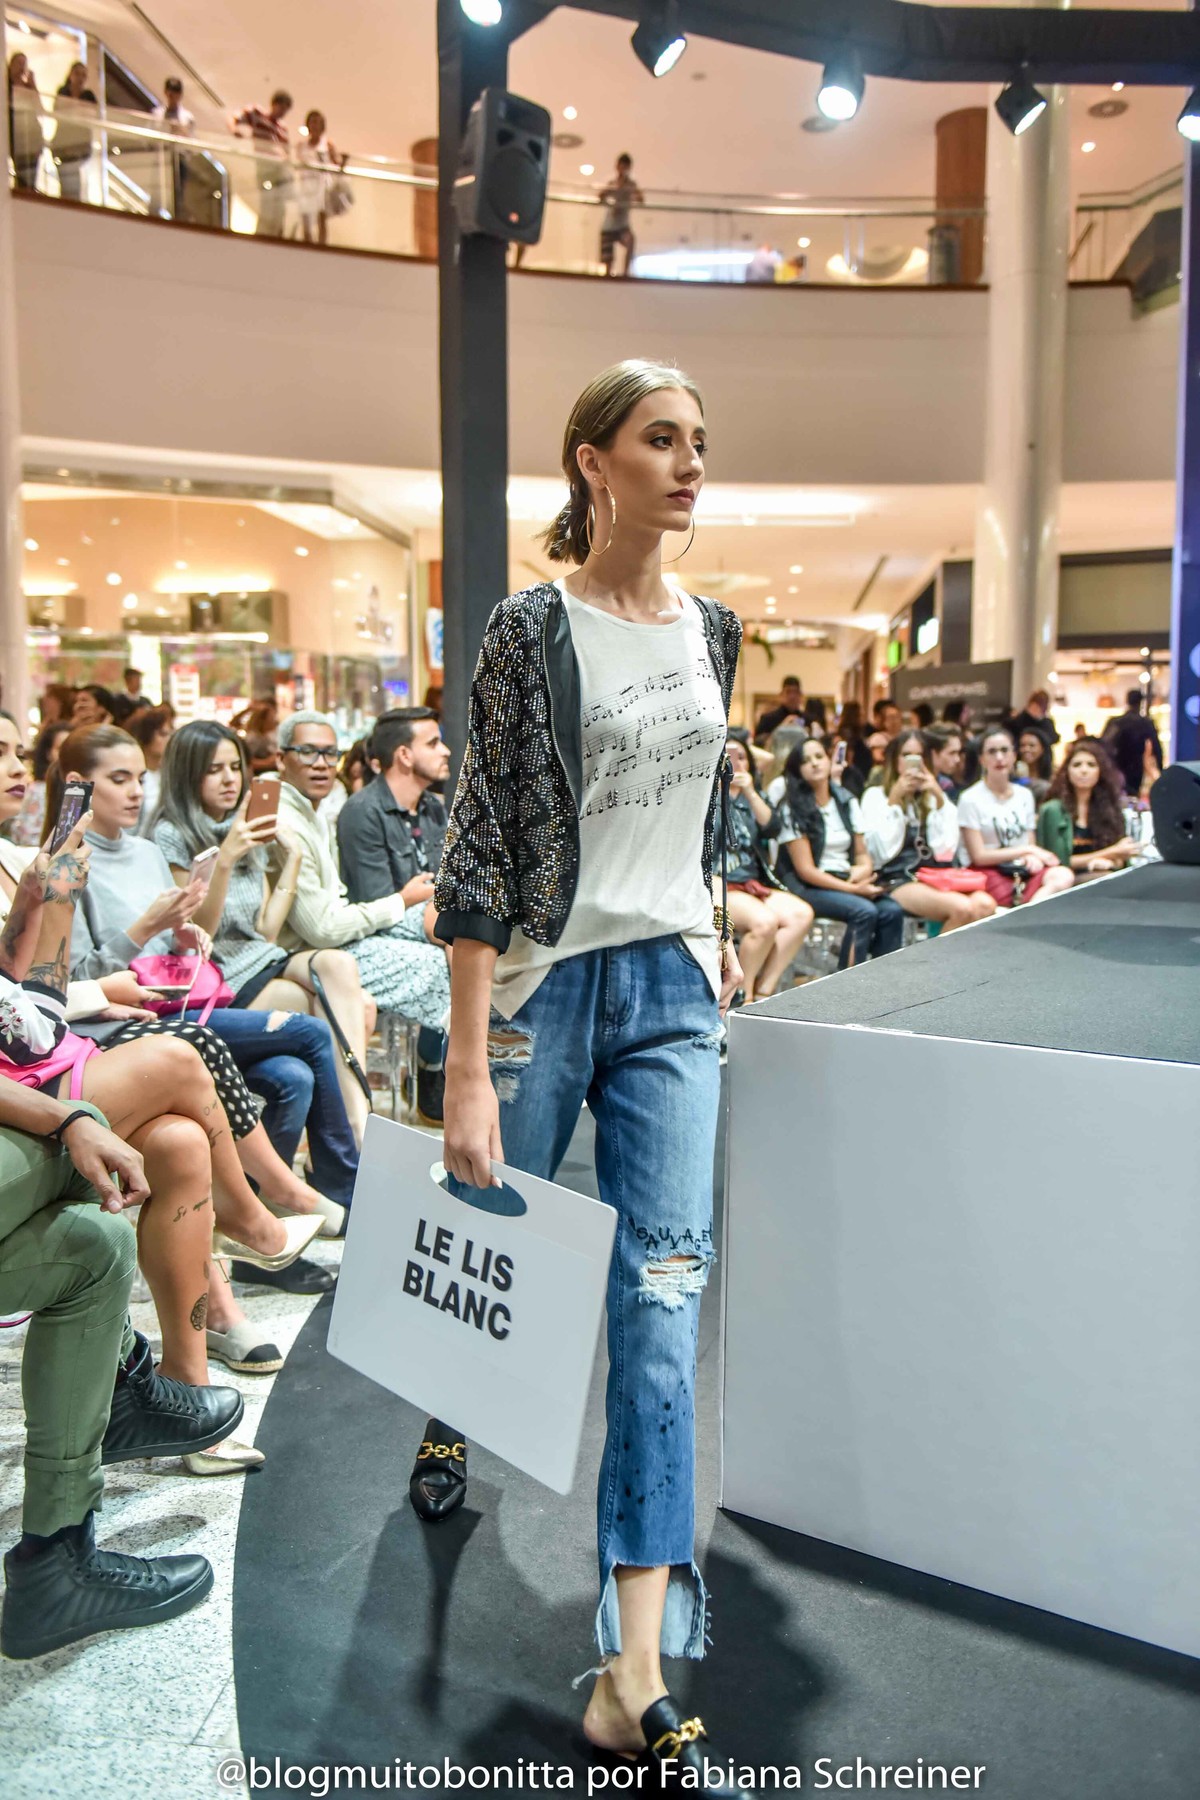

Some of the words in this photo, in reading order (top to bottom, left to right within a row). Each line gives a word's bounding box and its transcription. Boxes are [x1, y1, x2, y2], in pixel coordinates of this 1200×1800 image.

[415, 1218, 454, 1266] LE
[461, 1239, 514, 1292] LIS
[402, 1259, 512, 1341] BLANC
